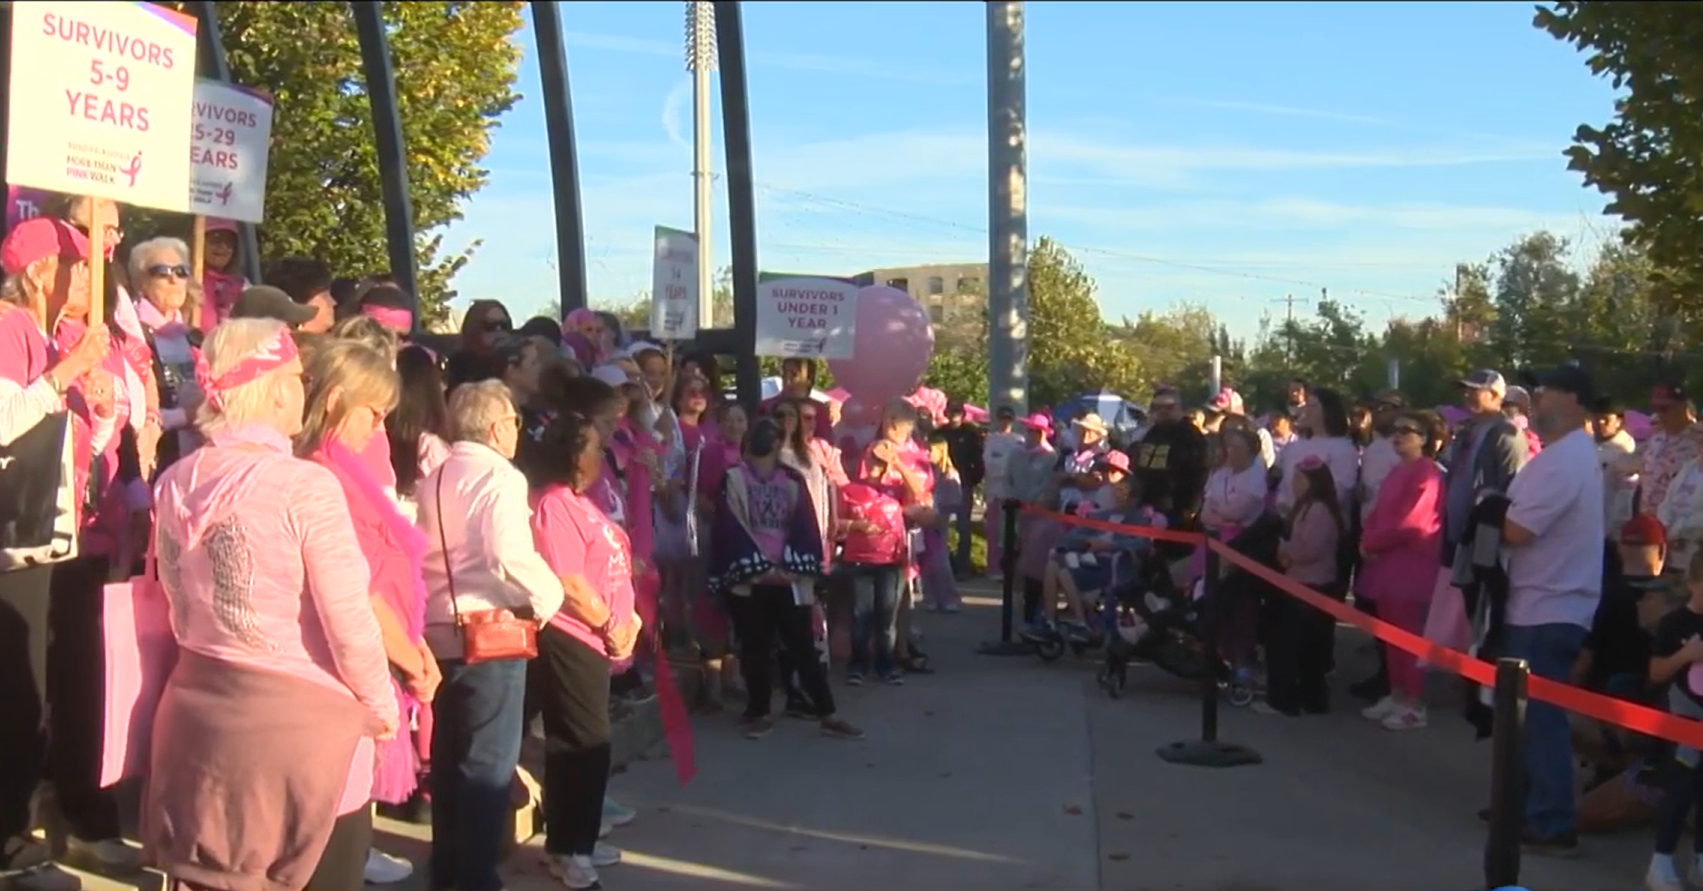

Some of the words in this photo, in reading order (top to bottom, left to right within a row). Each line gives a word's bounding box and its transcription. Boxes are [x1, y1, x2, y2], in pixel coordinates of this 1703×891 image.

[43, 13, 173, 69] SURVIVORS
[90, 59, 130, 92] 5-9
[65, 89, 149, 132] YEARS
[193, 101, 257, 128] VIVORS
[191, 123, 236, 146] 5-29
[190, 146, 238, 170] EARS
[90, 171, 116, 185] WALK
[772, 288, 845, 302] SURVIVORS
[777, 302, 828, 315] UNDER
[832, 305, 838, 316] 1
[787, 317, 827, 329] YEAR
